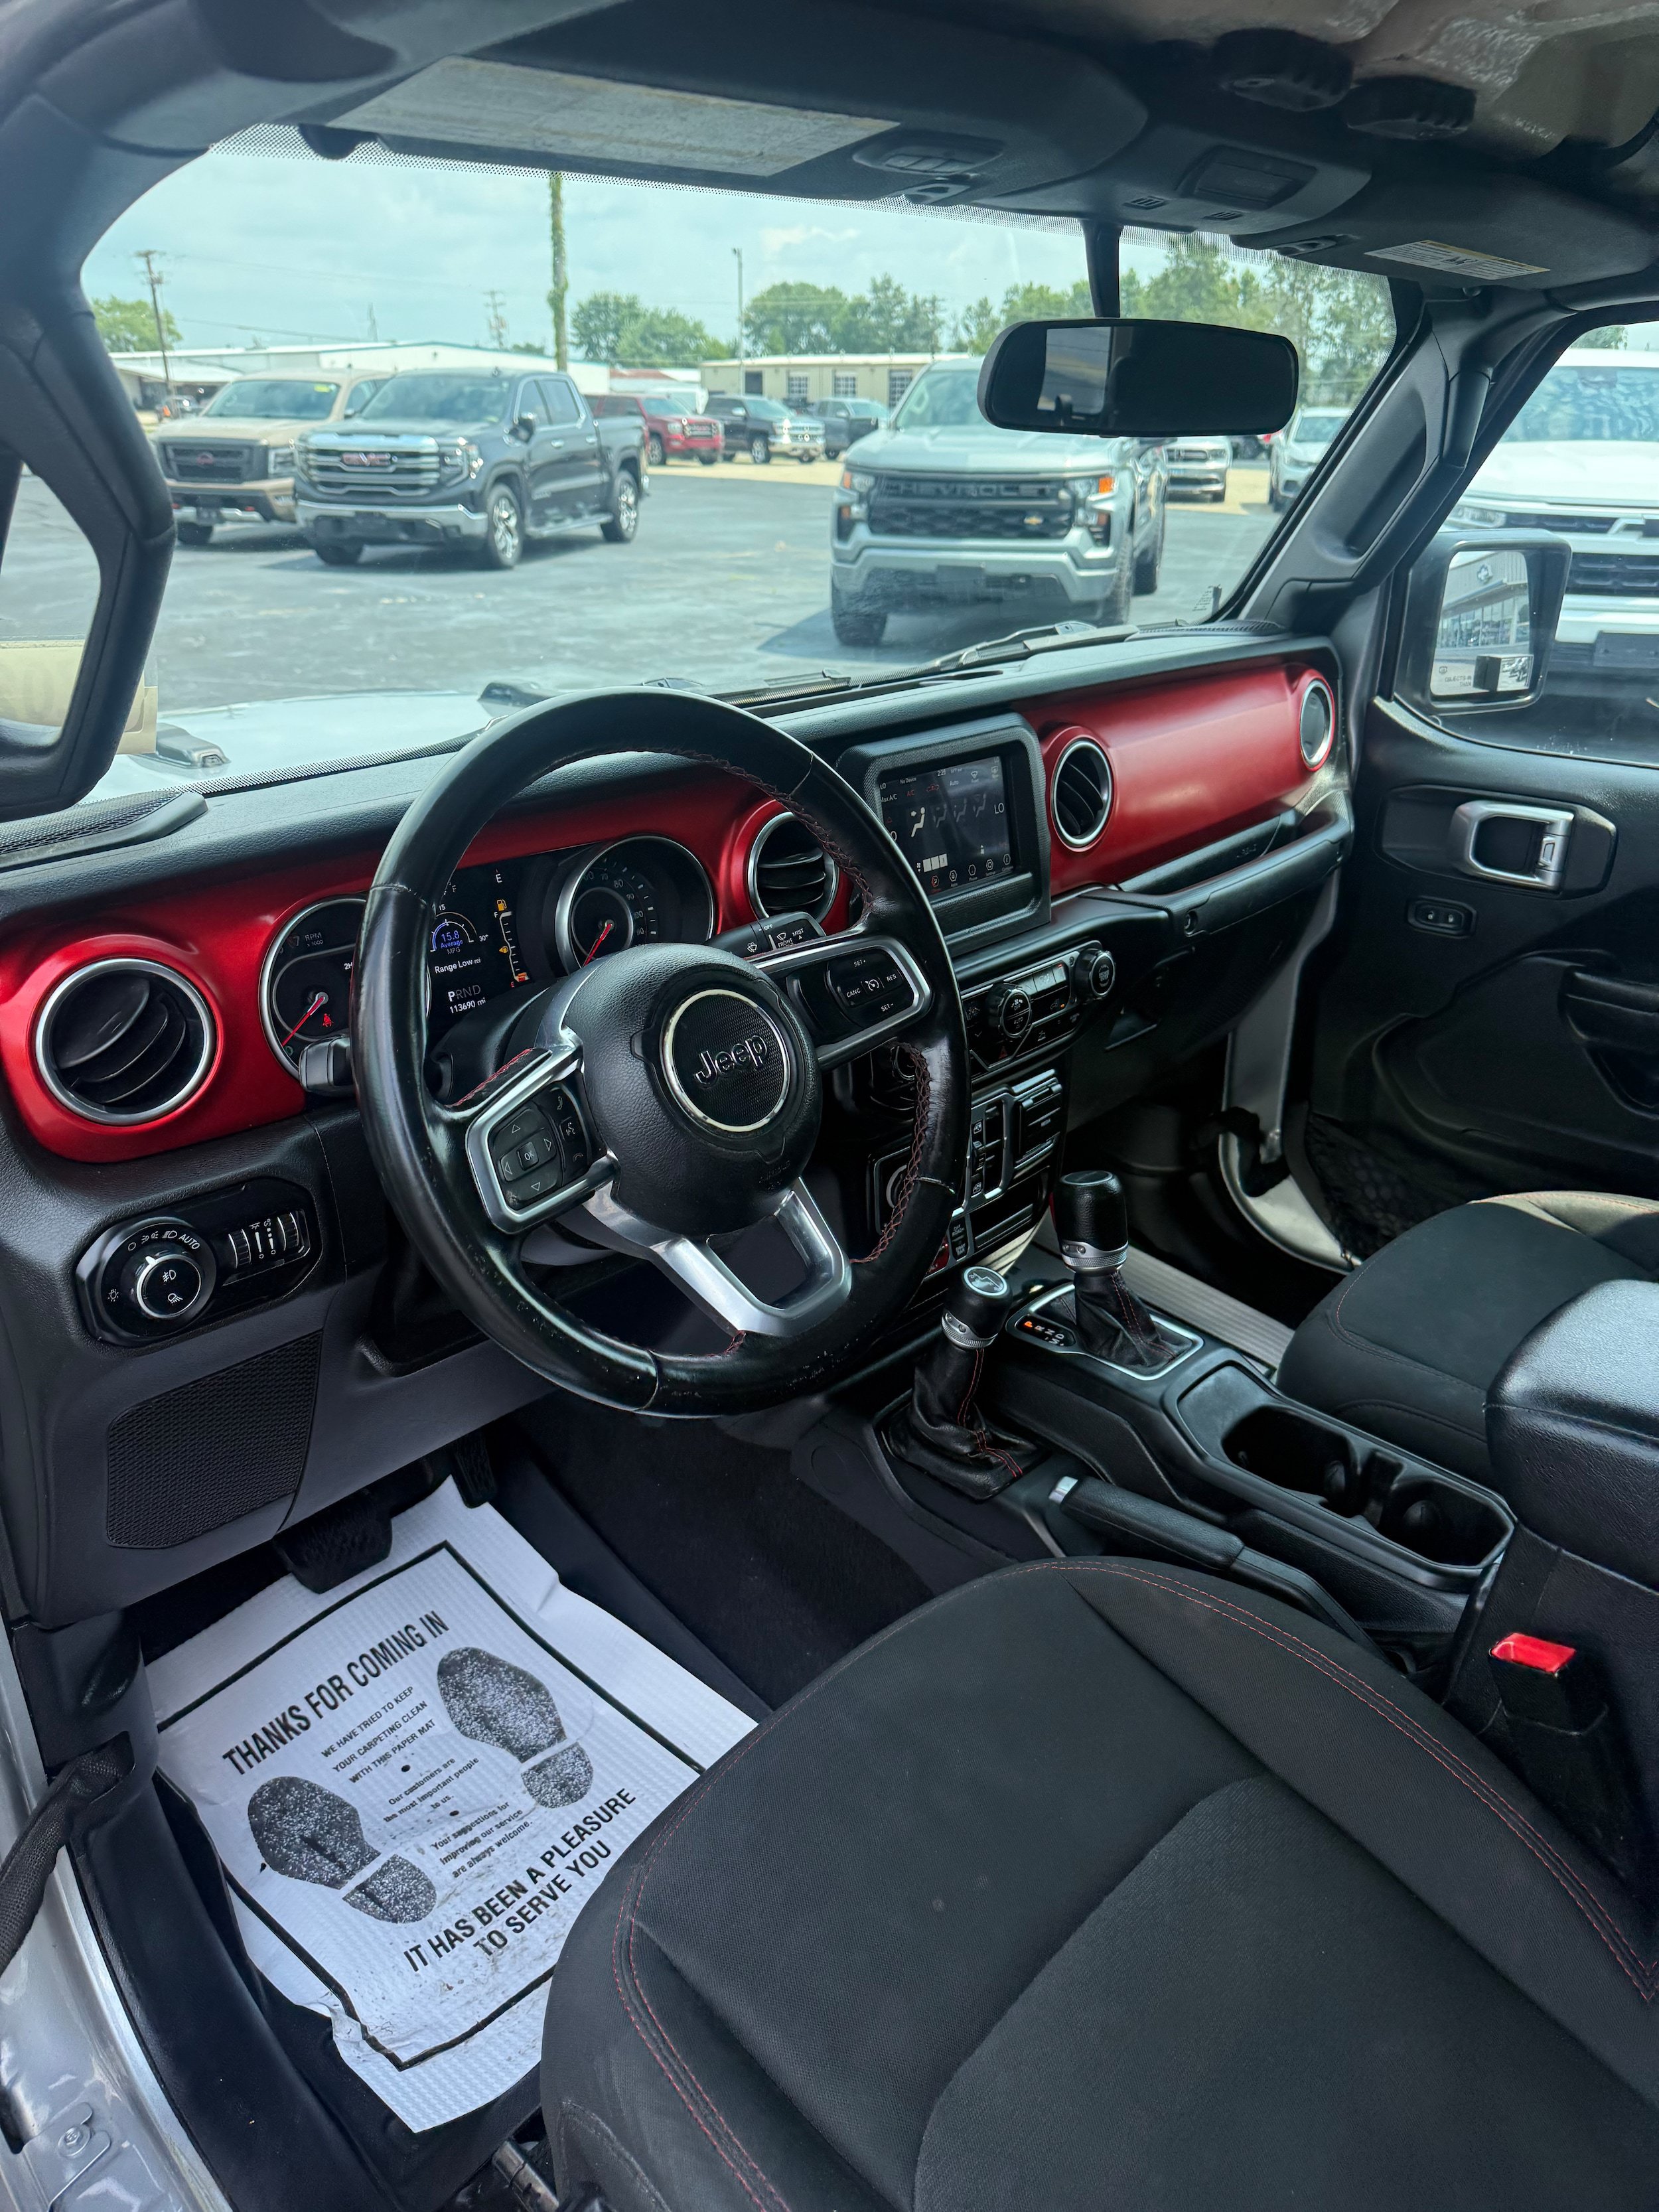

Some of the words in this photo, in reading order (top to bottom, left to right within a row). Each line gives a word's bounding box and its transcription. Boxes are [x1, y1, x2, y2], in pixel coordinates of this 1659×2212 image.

[994, 803, 1005, 814] LO
[494, 873, 502, 883] E
[614, 879, 624, 887] 80
[305, 932, 322, 942] RPM
[441, 930, 460, 942] 15.8
[792, 928, 804, 936] MIST
[441, 939, 463, 949] Average
[778, 938, 793, 948] FRONT
[434, 962, 457, 974] Range
[457, 958, 473, 968] Low
[846, 988, 861, 997] CANC
[449, 999, 476, 1014] 113690
[477, 997, 486, 1006] mi
[693, 1035, 767, 1084] Jeep
[524, 1150, 534, 1161] OK
[178, 1234, 200, 1250] AUTO
[222, 1704, 311, 1775] THANKS
[304, 1674, 354, 1720] FOR
[346, 1624, 428, 1686] COMING
[419, 1610, 450, 1639] IN
[321, 1744, 337, 1758] WE
[336, 1728, 360, 1747] HAVE
[357, 1711, 382, 1732] TRIED
[381, 1702, 394, 1714] TO
[394, 1686, 413, 1704] KEEP
[332, 1753, 358, 1773] YOUR
[357, 1721, 402, 1756] CARPETING
[401, 1700, 428, 1724] CLEAN
[348, 1765, 373, 1783] WITH
[371, 1751, 392, 1768] THIS
[392, 1733, 419, 1754] PAPER
[417, 1719, 436, 1735] MAT
[388, 1793, 404, 1805] Our
[404, 1767, 443, 1796] customers
[442, 1757, 456, 1769] are
[383, 1812, 398, 1823] the
[398, 1800, 418, 1815] most
[418, 1775, 455, 1803] important
[453, 1757, 479, 1779] people
[441, 1794, 455, 1804] us.
[430, 1836, 452, 1850] Your
[451, 1810, 498, 1839] suggestions
[497, 1801, 510, 1812] for
[480, 1826, 495, 1838] our
[494, 1808, 524, 1829] service
[452, 1865, 467, 1878] are
[467, 1846, 496, 1869] always
[494, 1820, 534, 1848] welcome.
[403, 1943, 429, 1972] IT
[427, 1918, 476, 1958] HAS
[470, 1879, 529, 1927] BEEN
[526, 1866, 546, 1885] A
[540, 1787, 637, 1868] PLEASURE
[472, 1929, 508, 1956] TO
[504, 1874, 573, 1934] SERVE
[565, 1839, 612, 1878] YOU
